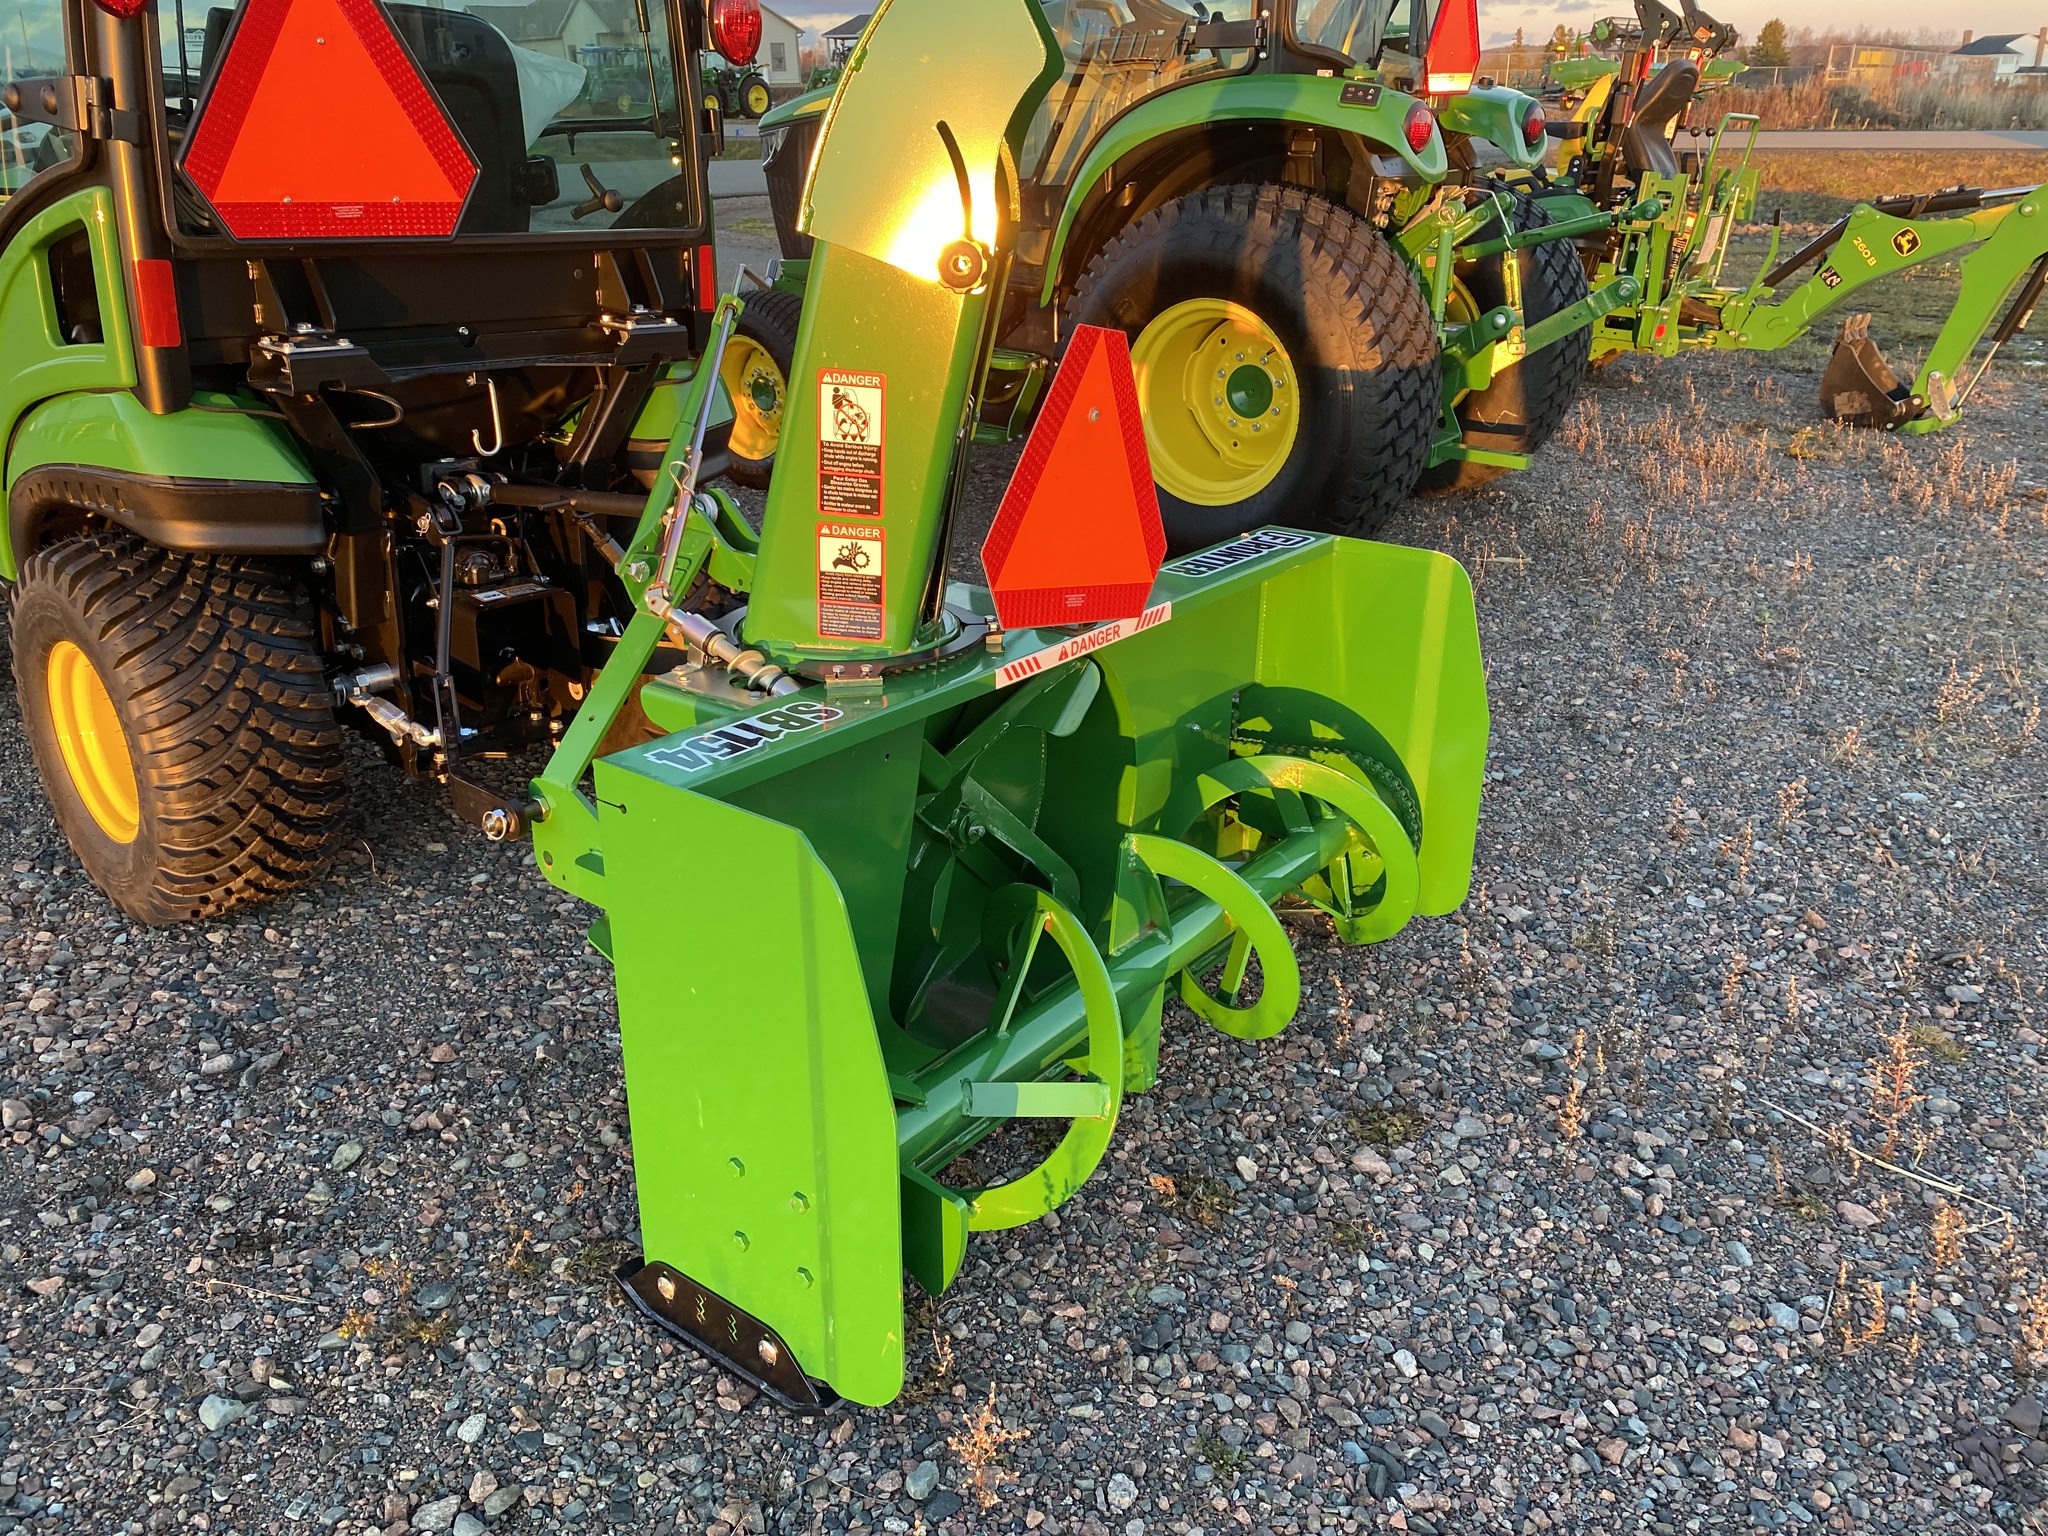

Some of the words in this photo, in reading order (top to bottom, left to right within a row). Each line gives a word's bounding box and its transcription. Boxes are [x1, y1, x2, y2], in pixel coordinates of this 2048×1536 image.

[831, 374, 880, 387] DANGER
[832, 525, 880, 538] DANGER
[1163, 530, 1314, 577] FRONTIER
[1070, 624, 1121, 657] DANGER
[643, 701, 844, 772] SB1154
